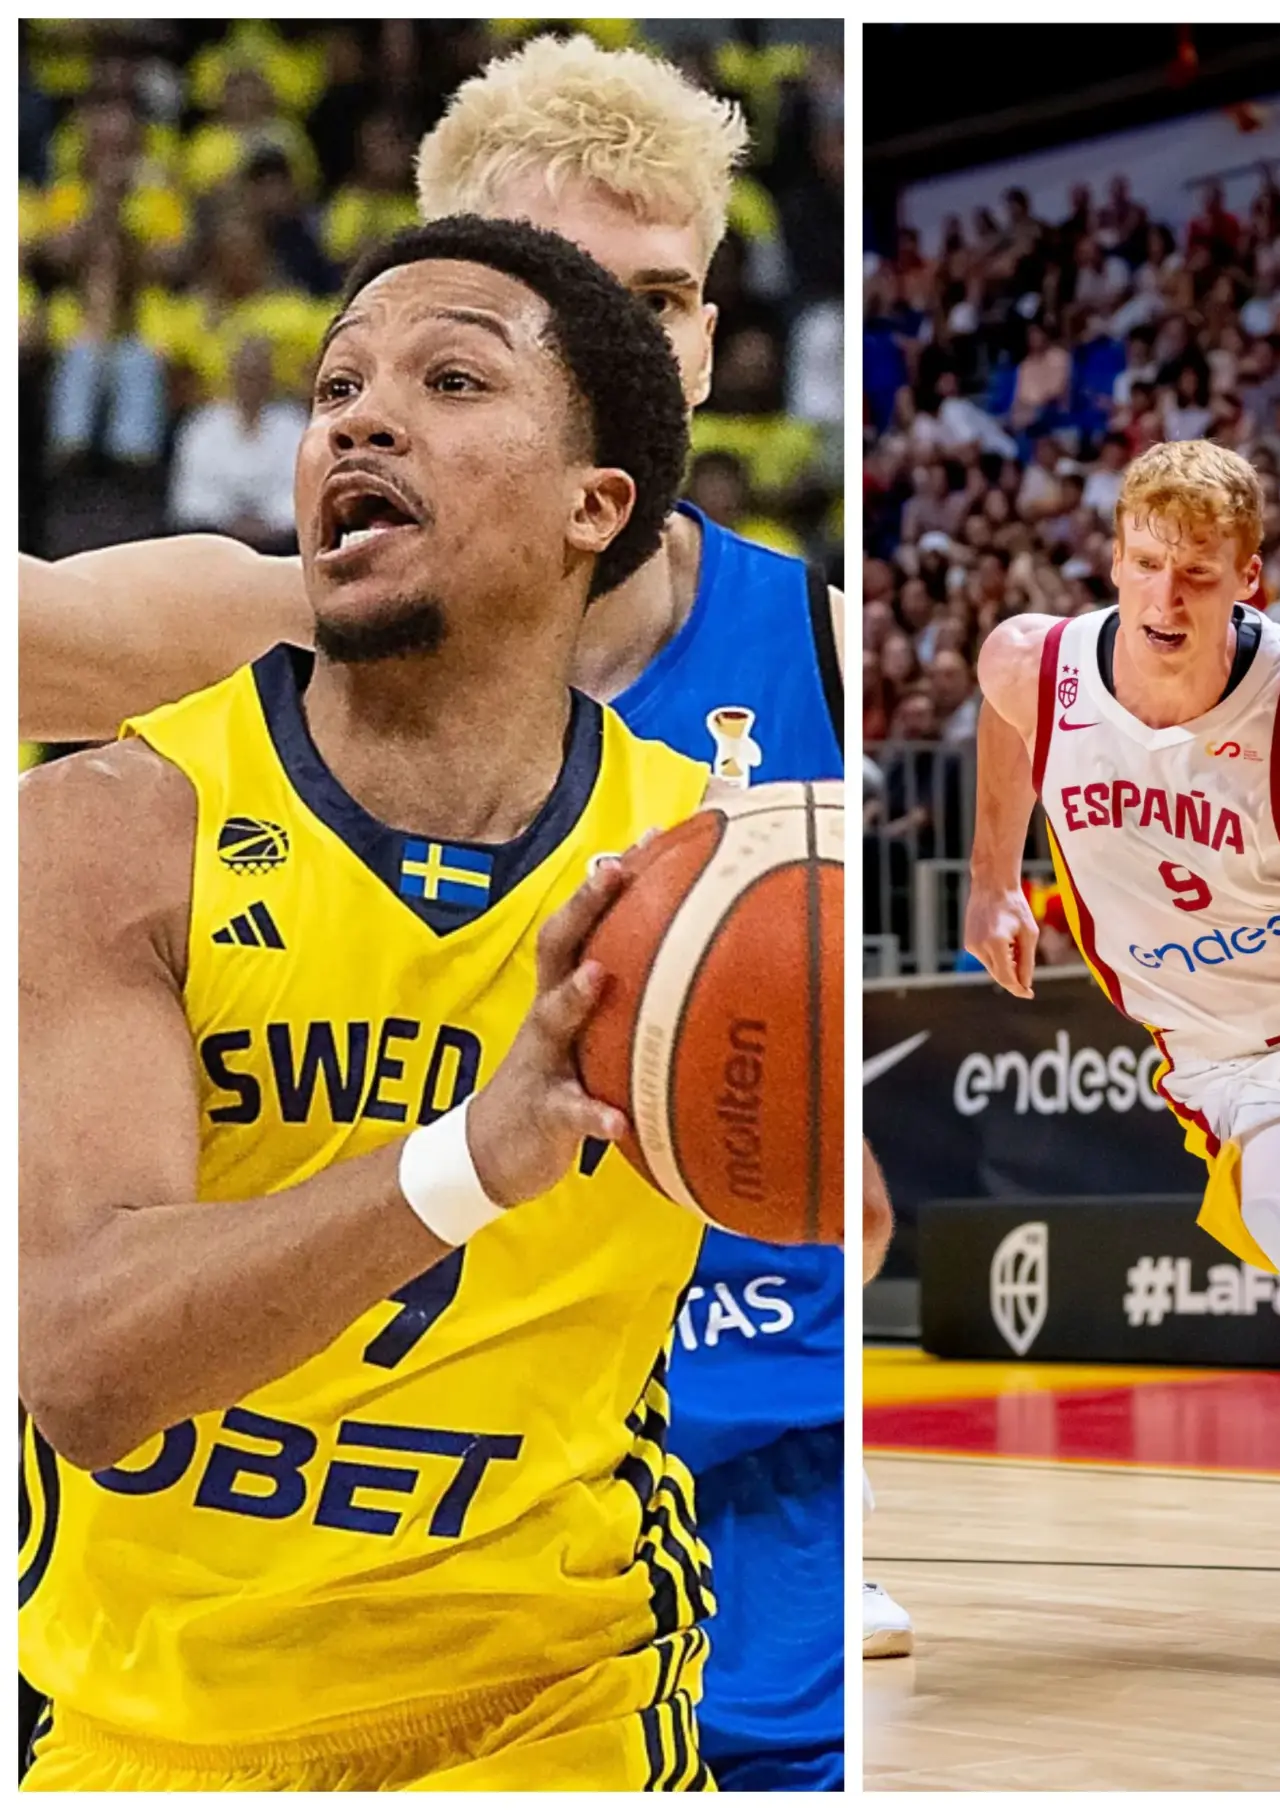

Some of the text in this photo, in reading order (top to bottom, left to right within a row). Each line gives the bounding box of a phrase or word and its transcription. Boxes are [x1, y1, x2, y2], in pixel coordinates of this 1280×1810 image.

[1061, 780, 1245, 855] ESPAÑA
[1158, 860, 1213, 912] 9
[715, 1018, 767, 1202] molten
